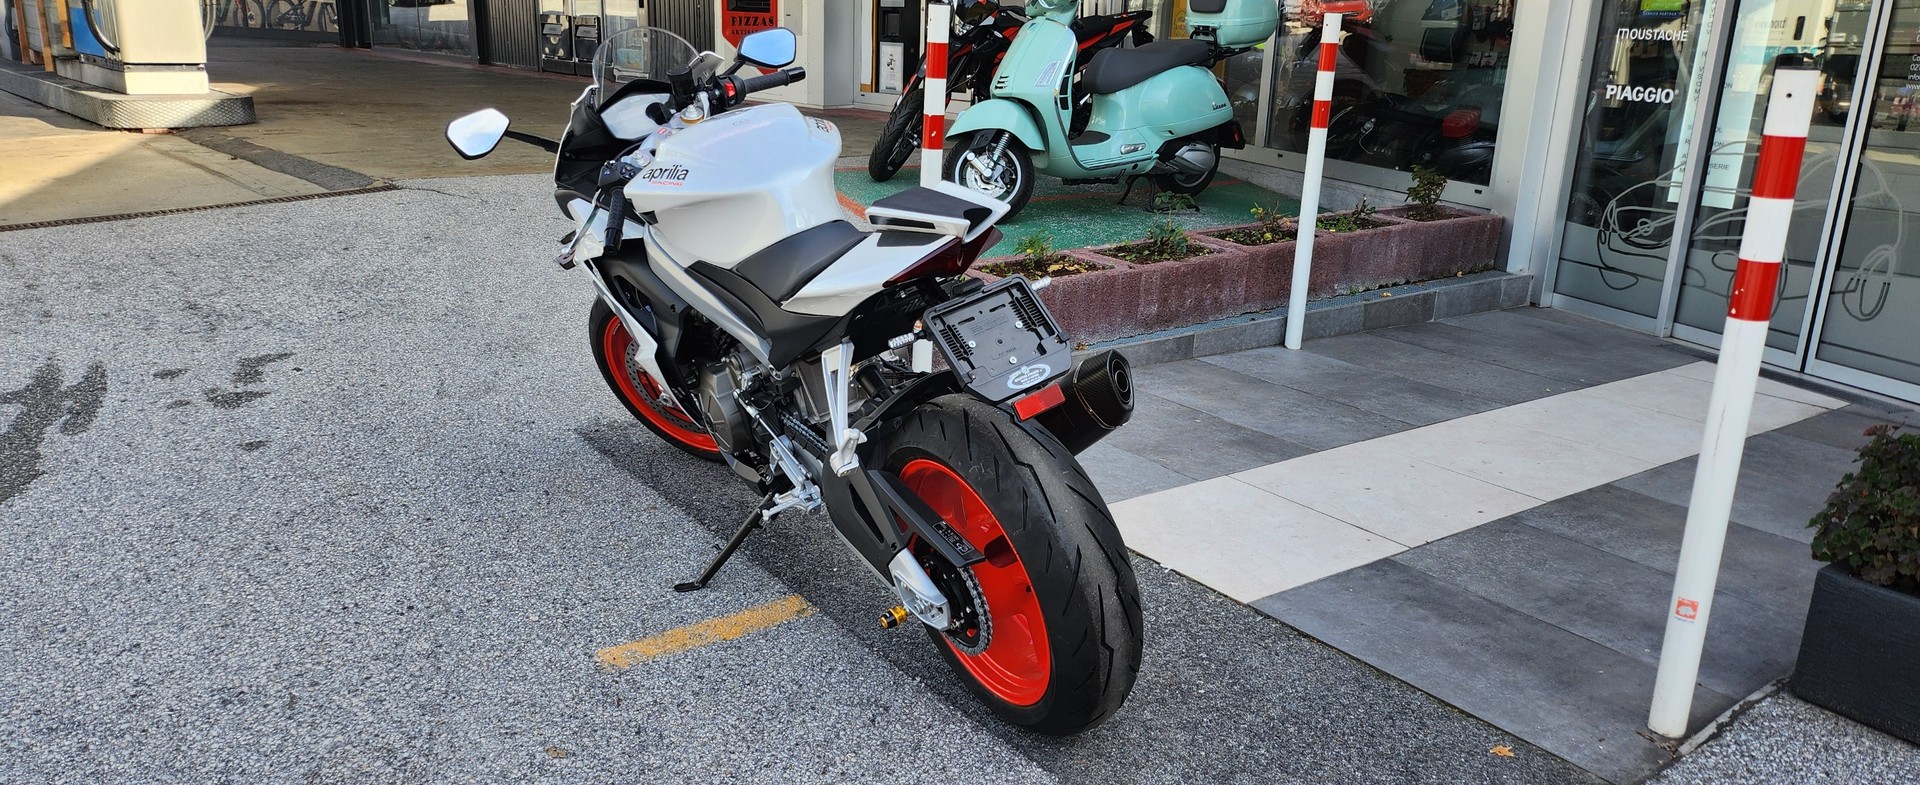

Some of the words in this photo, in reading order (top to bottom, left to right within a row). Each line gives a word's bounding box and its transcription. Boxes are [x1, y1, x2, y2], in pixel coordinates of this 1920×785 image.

[731, 16, 774, 26] PIZZAS
[1617, 28, 1688, 41] MOUSTACHE
[1605, 85, 1674, 104] PIAGGIO
[642, 164, 690, 182] aprilia
